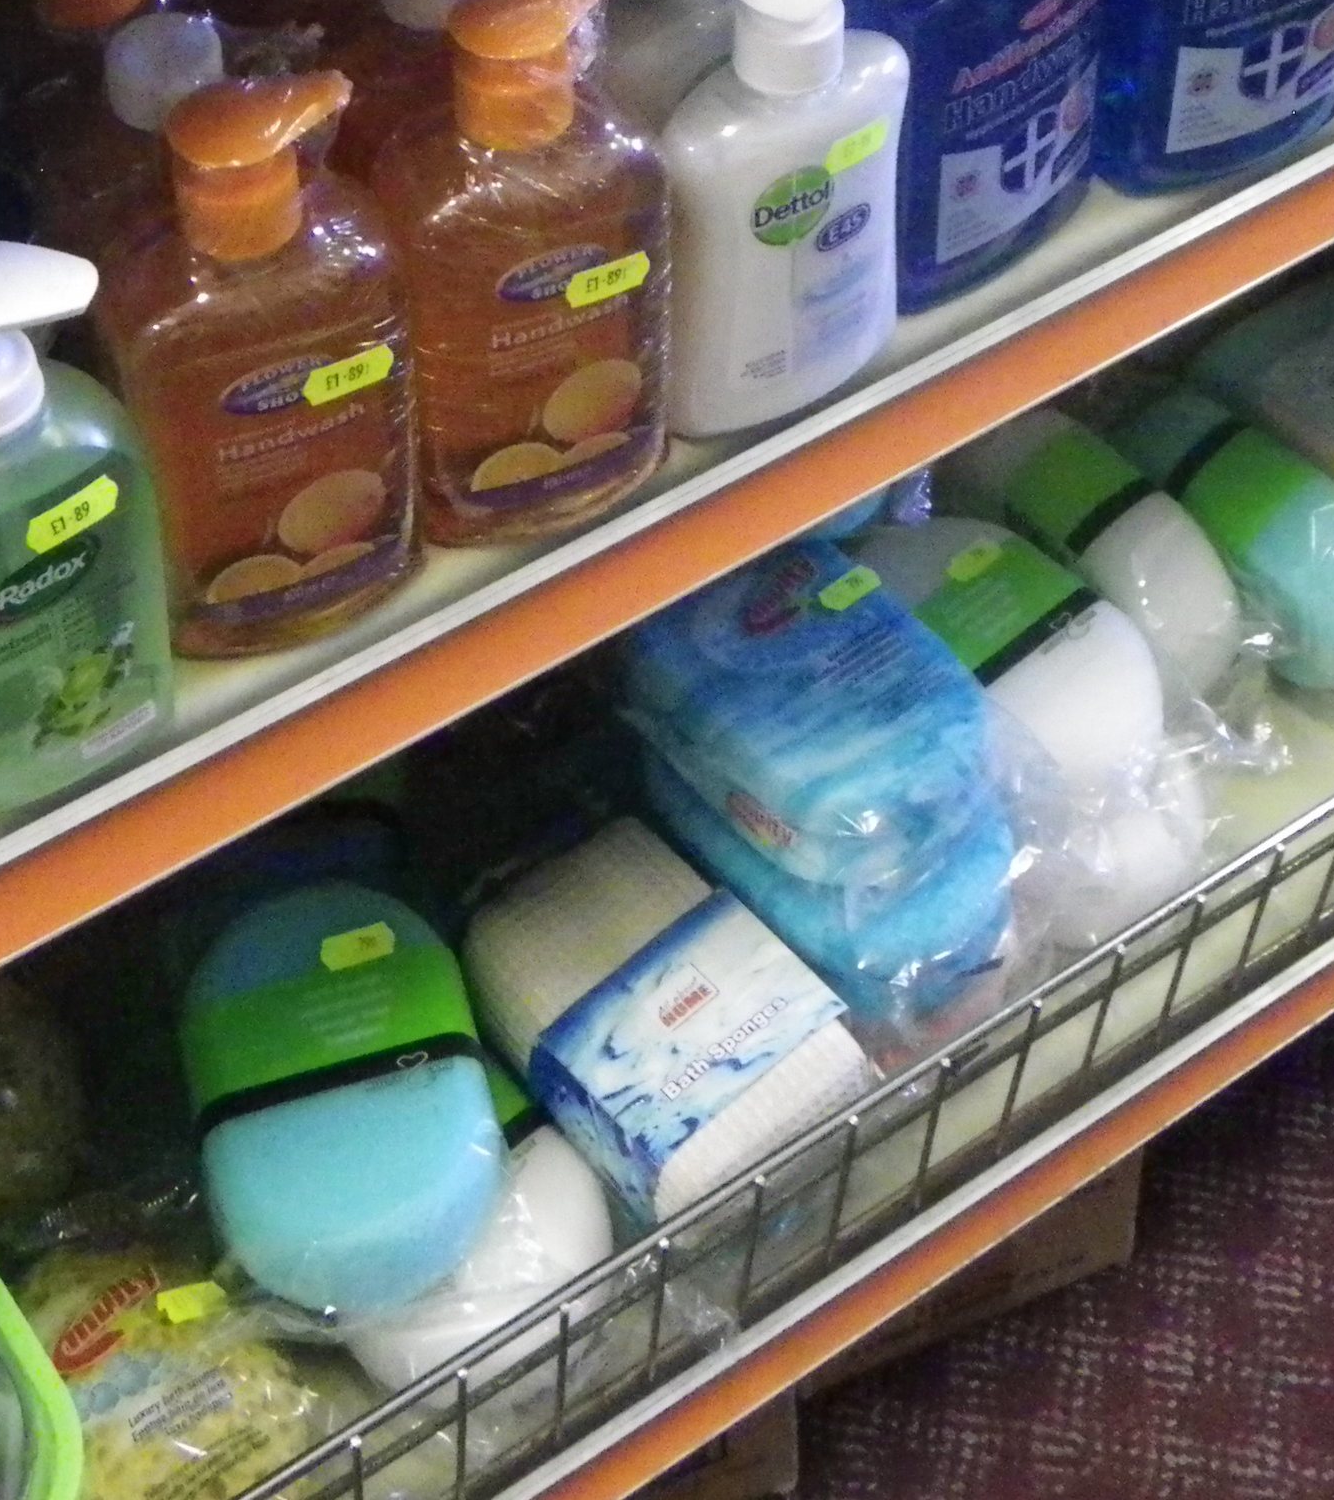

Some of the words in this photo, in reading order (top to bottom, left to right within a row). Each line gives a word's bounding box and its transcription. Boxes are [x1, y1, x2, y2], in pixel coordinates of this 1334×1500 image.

[754, 183, 832, 228] Dettol
[533, 281, 568, 298] SHO
[492, 295, 629, 348] Handwash
[258, 392, 299, 411] SHO
[220, 405, 365, 460] Handwash
[51, 502, 90, 535] £1.89
[660, 1060, 708, 1100] Bath
[711, 997, 789, 1068] Sponges
[127, 1402, 162, 1427] Luxury
